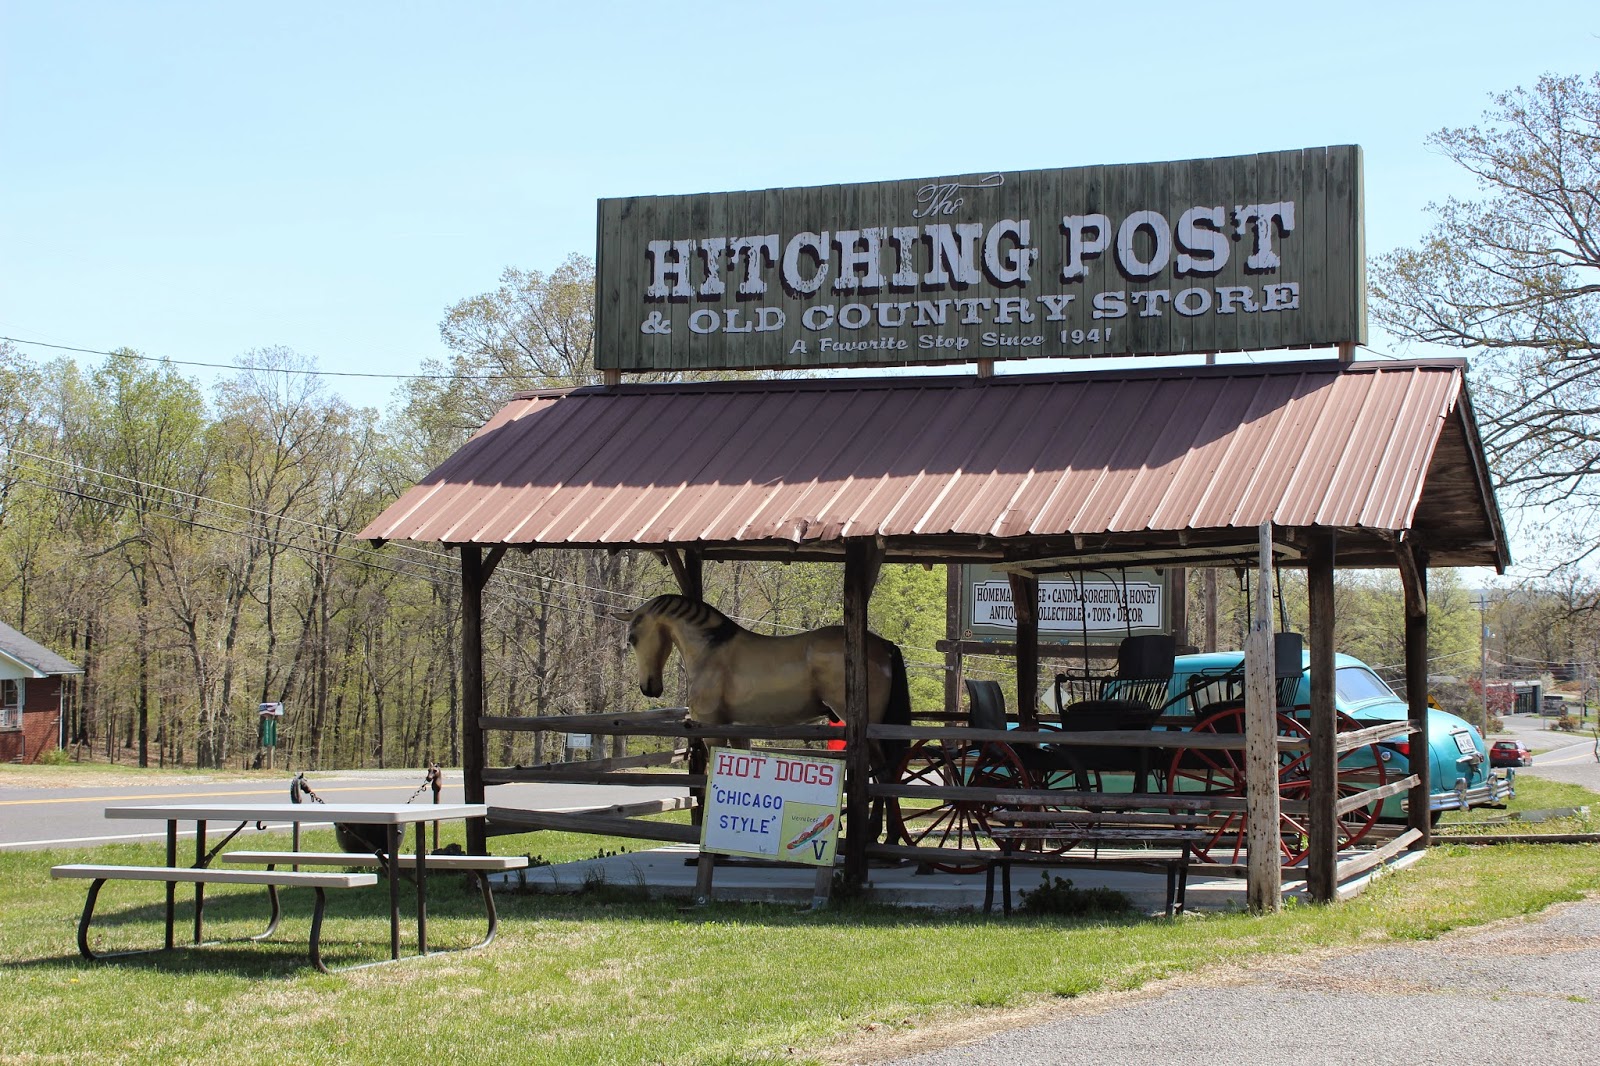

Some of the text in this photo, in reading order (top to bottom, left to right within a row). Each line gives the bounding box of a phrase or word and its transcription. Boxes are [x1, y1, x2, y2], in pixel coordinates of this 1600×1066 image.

[645, 201, 1296, 300] HITCHING POST
[640, 282, 1300, 335] & OLD COUNTRY STORE
[789, 327, 1113, 354] A Favorite Stop Since 1941
[976, 588, 1013, 602] HOMEMA
[1052, 588, 1078, 603] CANDY
[1083, 589, 1120, 604] SORGHUM
[1129, 589, 1157, 604] HONEY
[989, 605, 1143, 623] ANTIQ OLLECTIBLE TOYS DECOR
[716, 754, 834, 786] HOT DOGS
[811, 839, 828, 861] V
